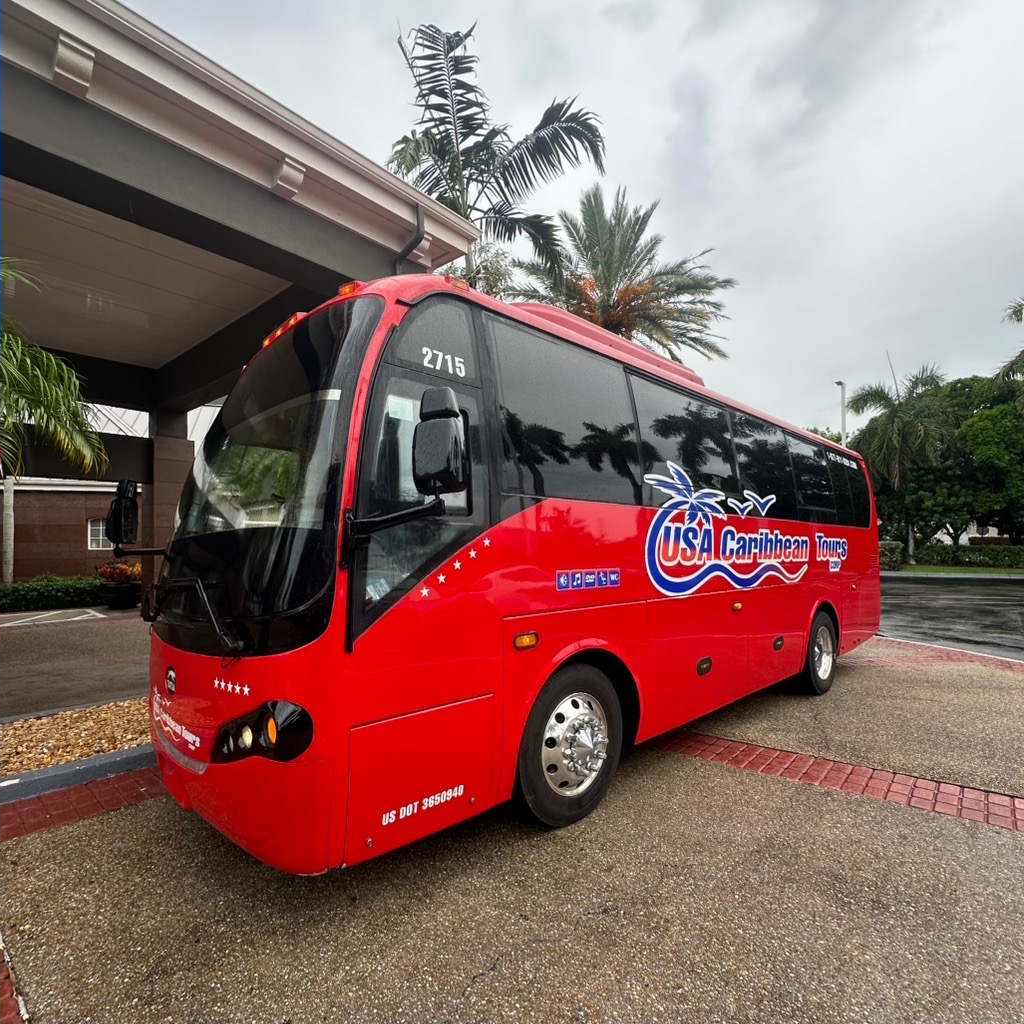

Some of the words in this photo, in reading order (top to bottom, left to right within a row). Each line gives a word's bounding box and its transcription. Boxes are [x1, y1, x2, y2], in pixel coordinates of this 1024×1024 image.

[421, 346, 466, 378] 2715
[659, 523, 713, 566] USA
[721, 527, 810, 565] Caribbean
[816, 532, 848, 562] Tours
[382, 809, 397, 826] US
[399, 801, 419, 820] DOT
[422, 785, 465, 812] 3650940
